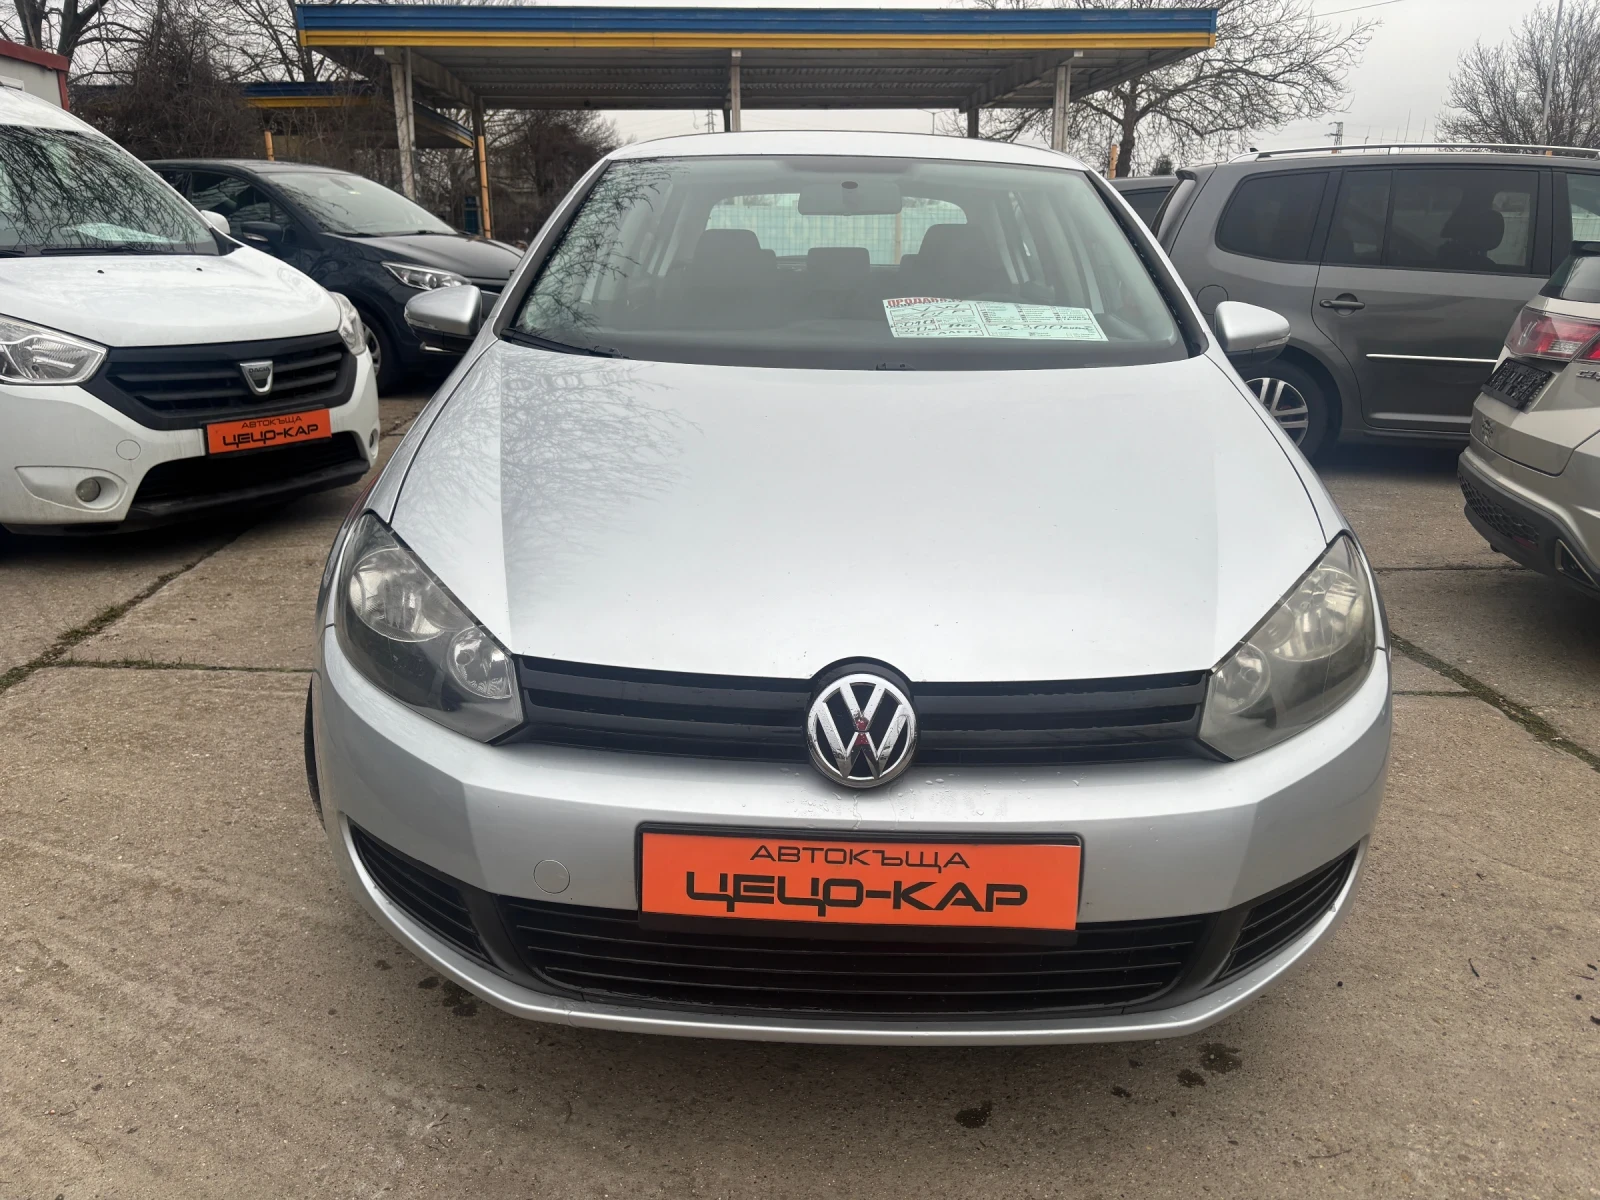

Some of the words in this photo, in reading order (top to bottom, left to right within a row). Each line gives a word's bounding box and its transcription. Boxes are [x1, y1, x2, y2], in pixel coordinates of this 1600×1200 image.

[222, 424, 319, 448] ЦЕЦО-КАР
[241, 415, 303, 429] АВТОКЪЩА
[808, 674, 917, 788] VW
[750, 844, 970, 873] АВТОКЪЩА
[686, 871, 1028, 917] ЦЕЦО-КАР
